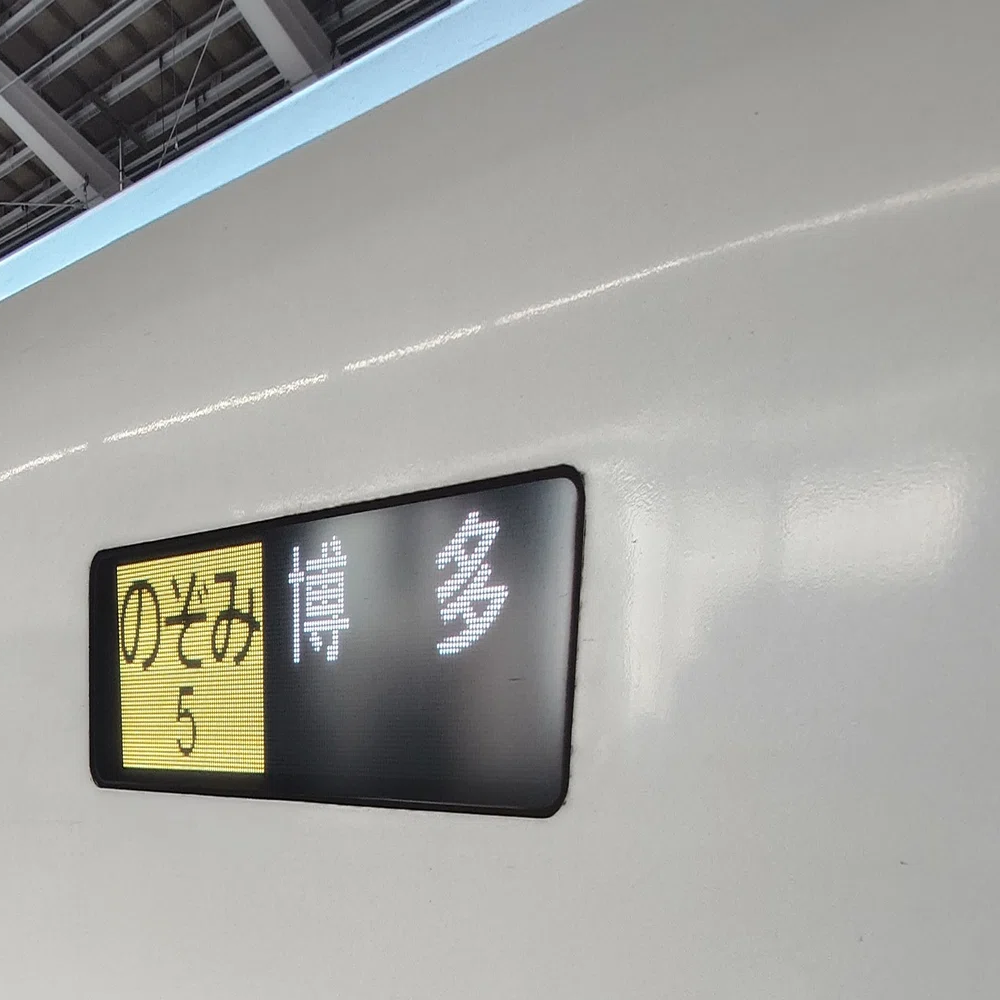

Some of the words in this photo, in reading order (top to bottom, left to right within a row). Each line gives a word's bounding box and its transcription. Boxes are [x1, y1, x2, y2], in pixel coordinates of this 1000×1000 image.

[121, 571, 260, 670] のぞみ
[288, 511, 509, 664] 博多
[176, 686, 197, 756] 5
